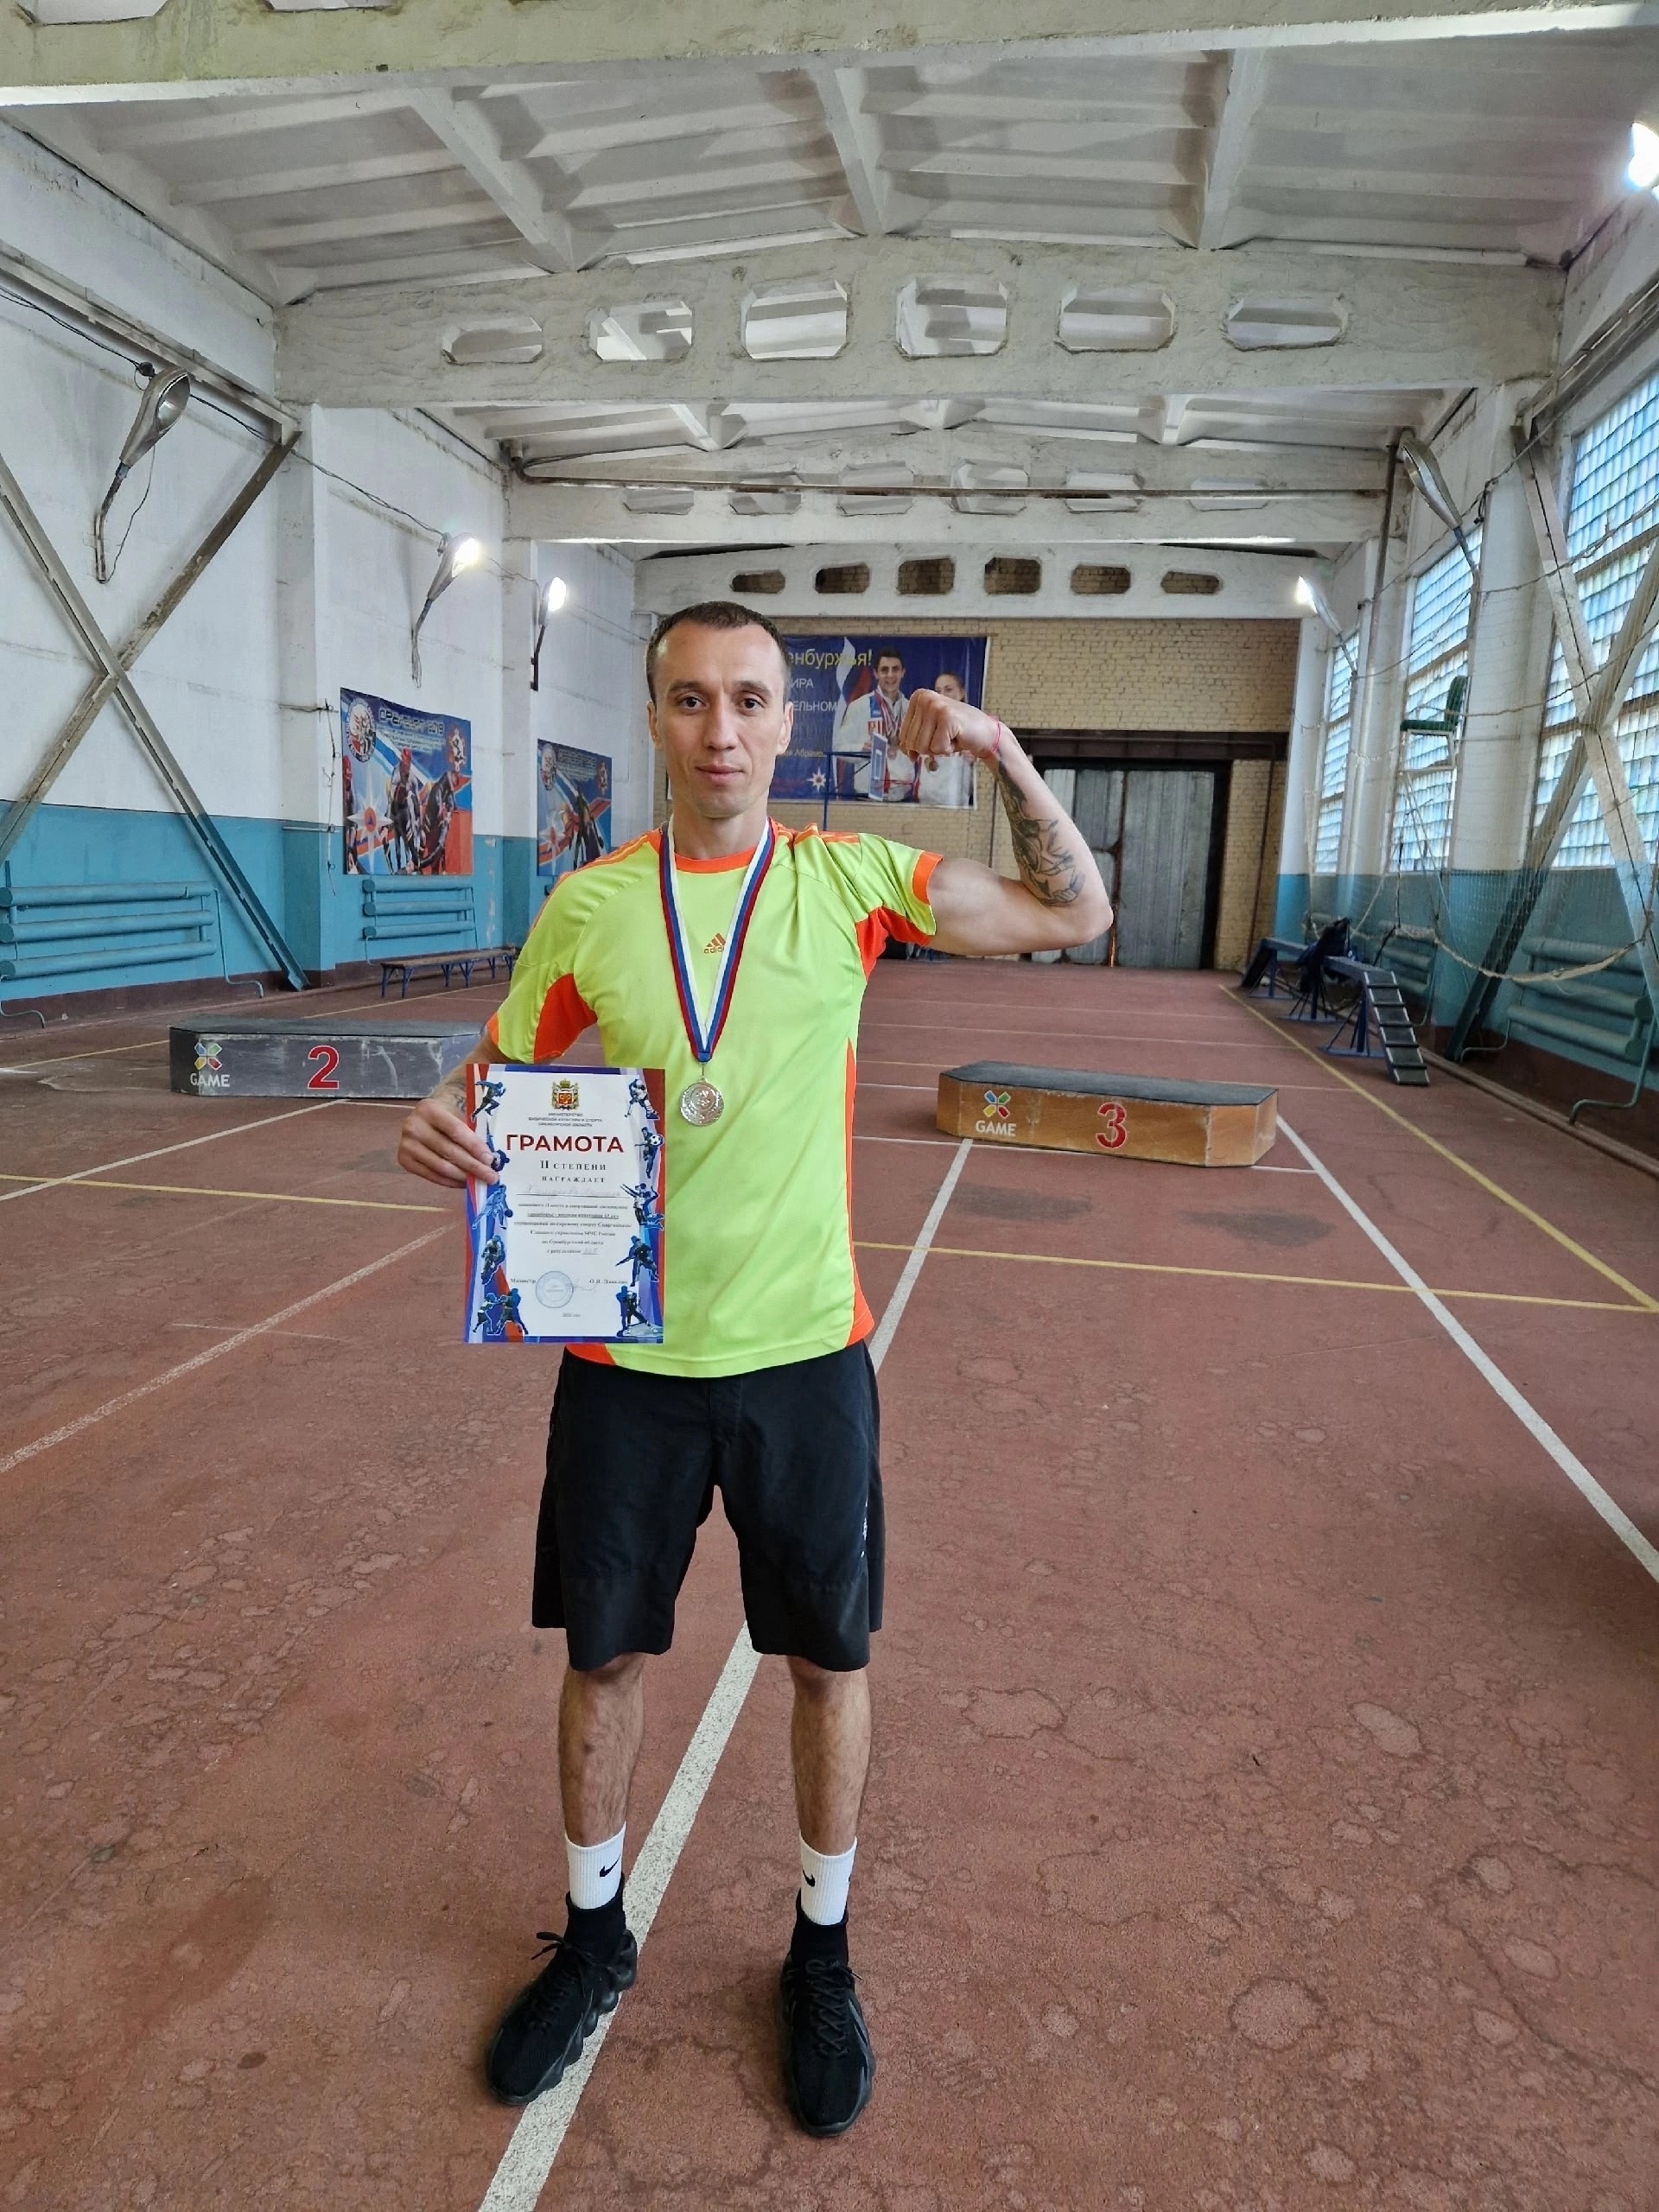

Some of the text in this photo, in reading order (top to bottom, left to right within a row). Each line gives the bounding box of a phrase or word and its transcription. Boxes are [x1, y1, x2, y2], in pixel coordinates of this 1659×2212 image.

[790, 677, 814, 689] ИРА
[792, 701, 838, 712] ЕЛЬНОМ
[704, 945, 725, 954] adid
[307, 1045, 340, 1090] 2
[190, 1072, 231, 1088] GAME
[976, 1121, 1016, 1137] GAME
[1095, 1102, 1128, 1149] 3
[506, 1134, 625, 1154] ГРАМОТА
